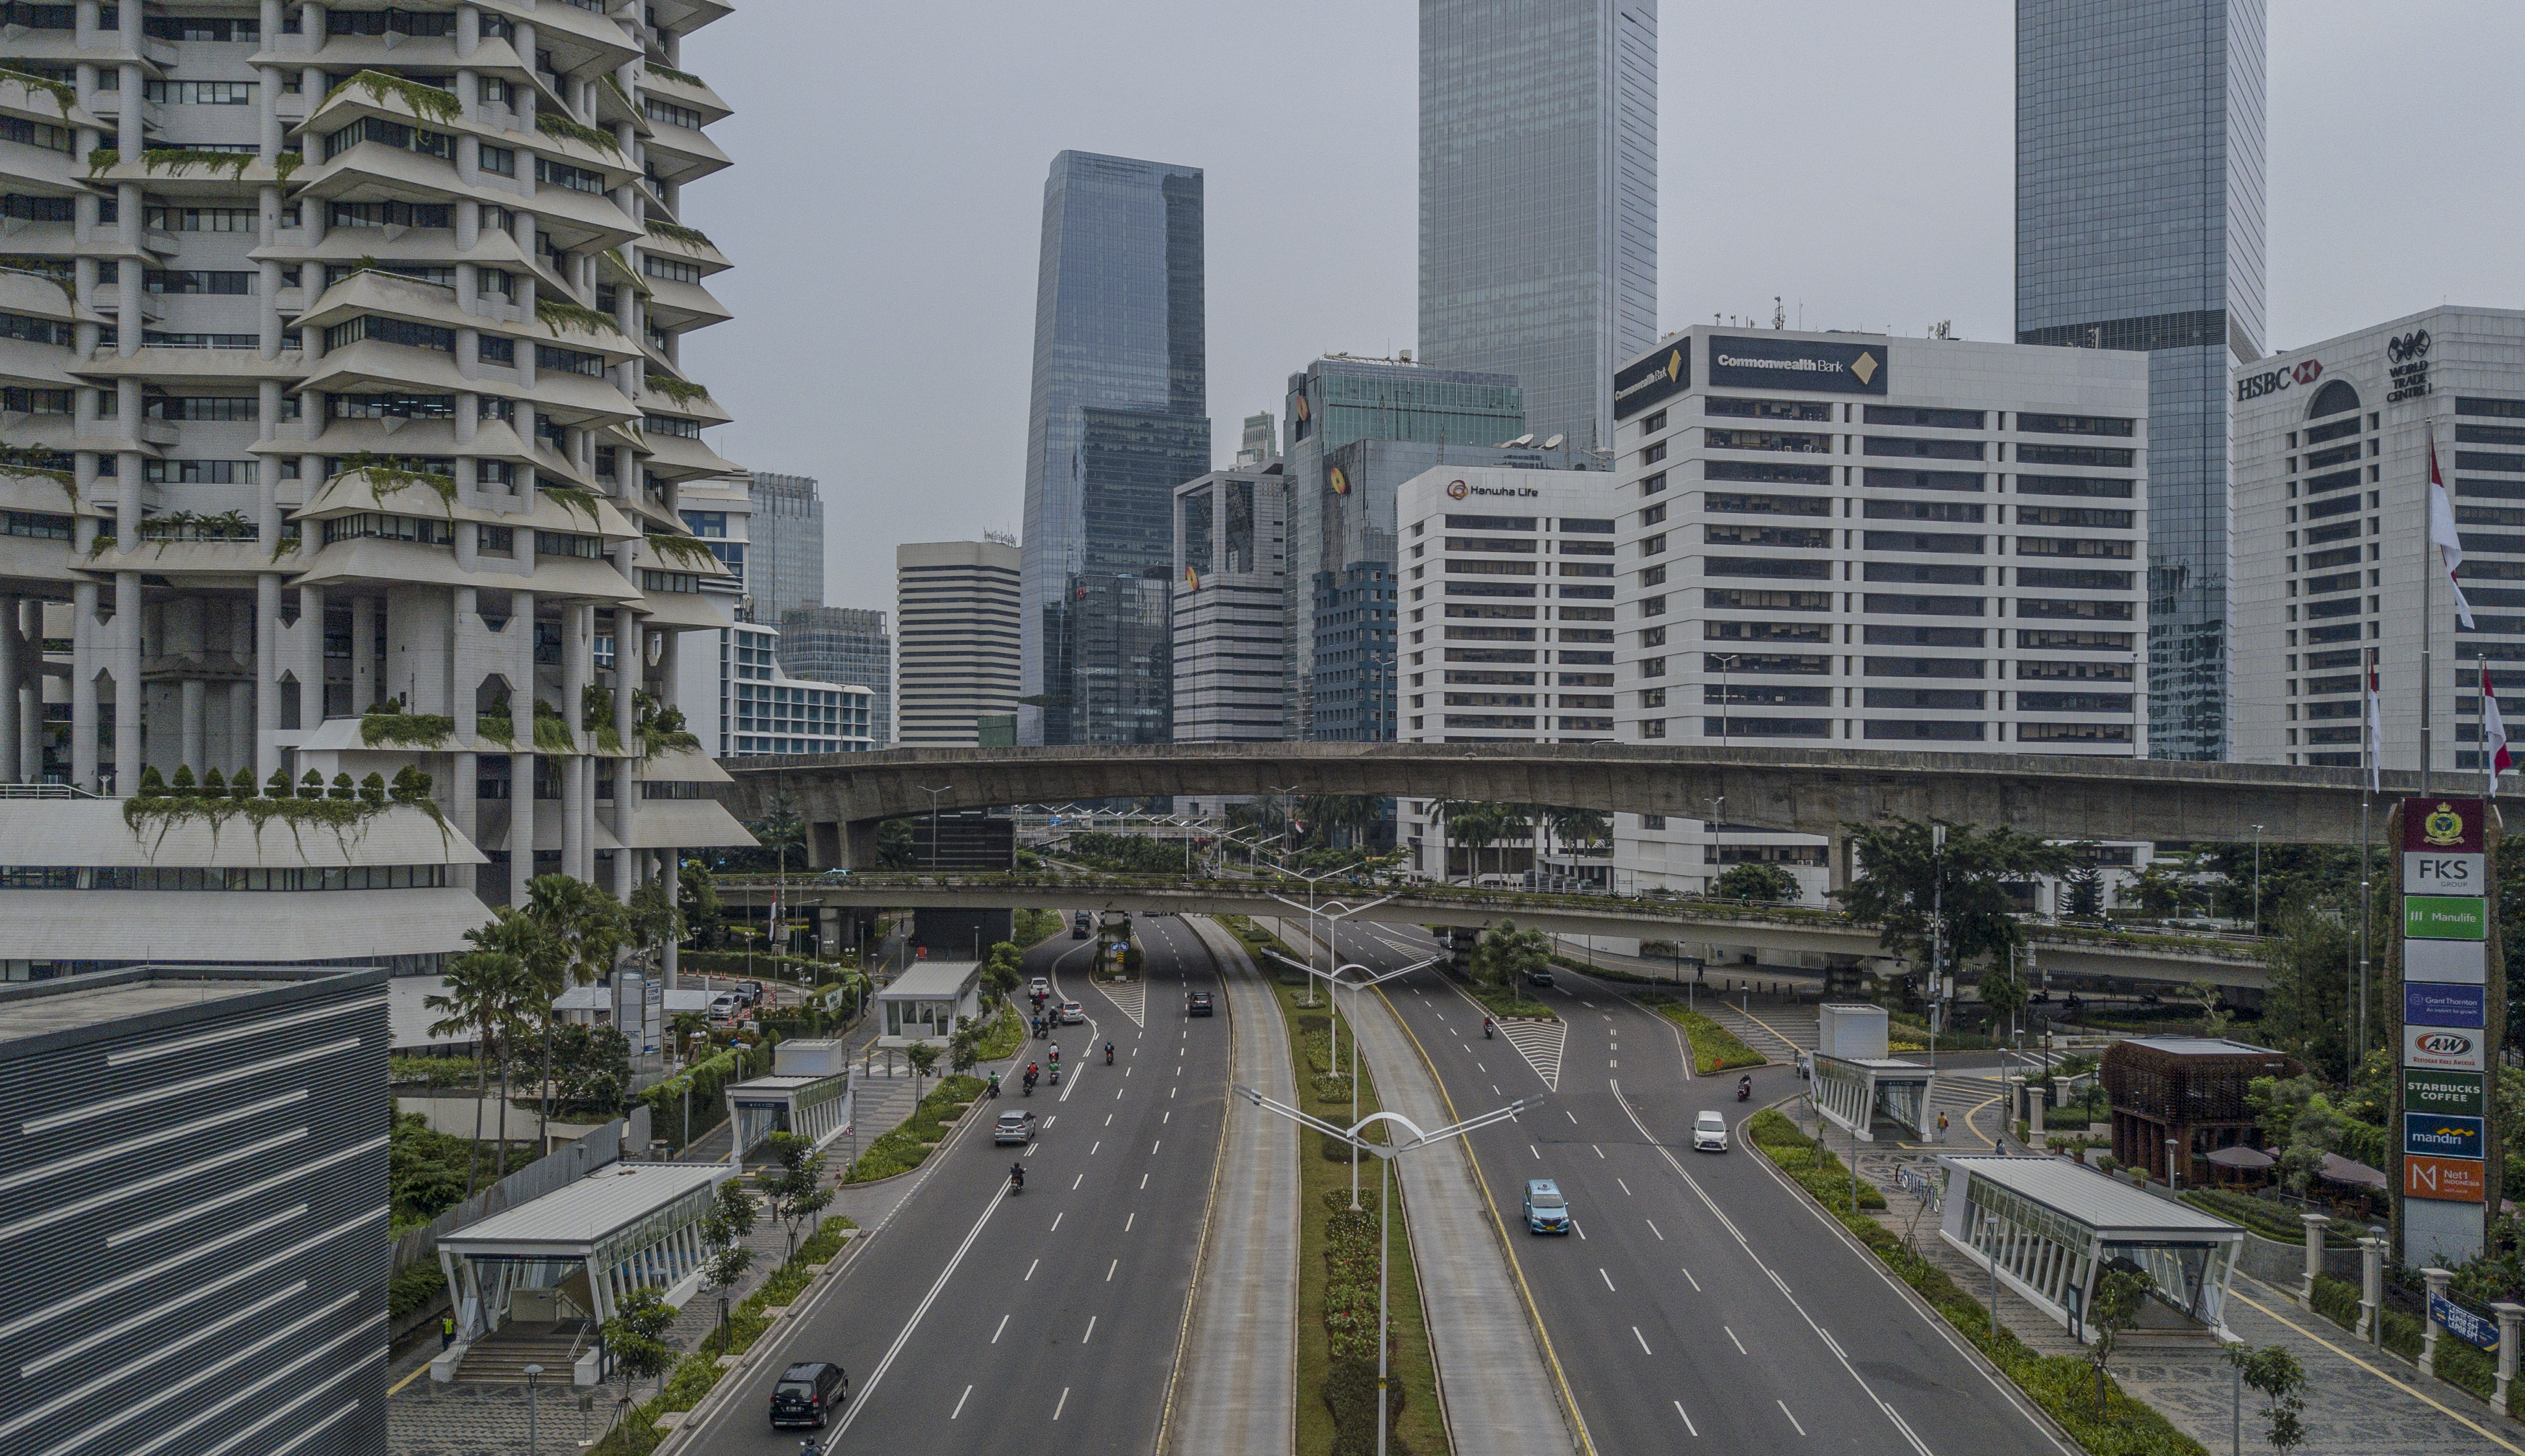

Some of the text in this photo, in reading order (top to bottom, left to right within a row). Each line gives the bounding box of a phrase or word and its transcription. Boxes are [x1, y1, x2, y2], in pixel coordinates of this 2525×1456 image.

[1718, 355, 1843, 373] Commonwealth Bank
[2389, 360, 2428, 378] WORLD
[2237, 366, 2291, 402] HSBC
[2392, 372, 2427, 390] TRADE
[2387, 385, 2426, 402] CENTRE
[1471, 486, 1538, 497] Hanwha Life
[2420, 859, 2468, 879] FKS
[2431, 912, 2477, 923] Manulife
[2446, 998, 2478, 1006] Thornton
[2427, 1038, 2465, 1051] A&W
[2407, 1082, 2480, 1094] STARBUCKS
[2420, 1092, 2467, 1102] COFFEE
[2412, 1133, 2461, 1144] mandiri
[2444, 1170, 2468, 1179] Net1
[2448, 1312, 2467, 1327] LAPOR
[2467, 1322, 2479, 1333] SPT
[2448, 1318, 2467, 1336] LAPOR
[2467, 1329, 2478, 1342] SPT
